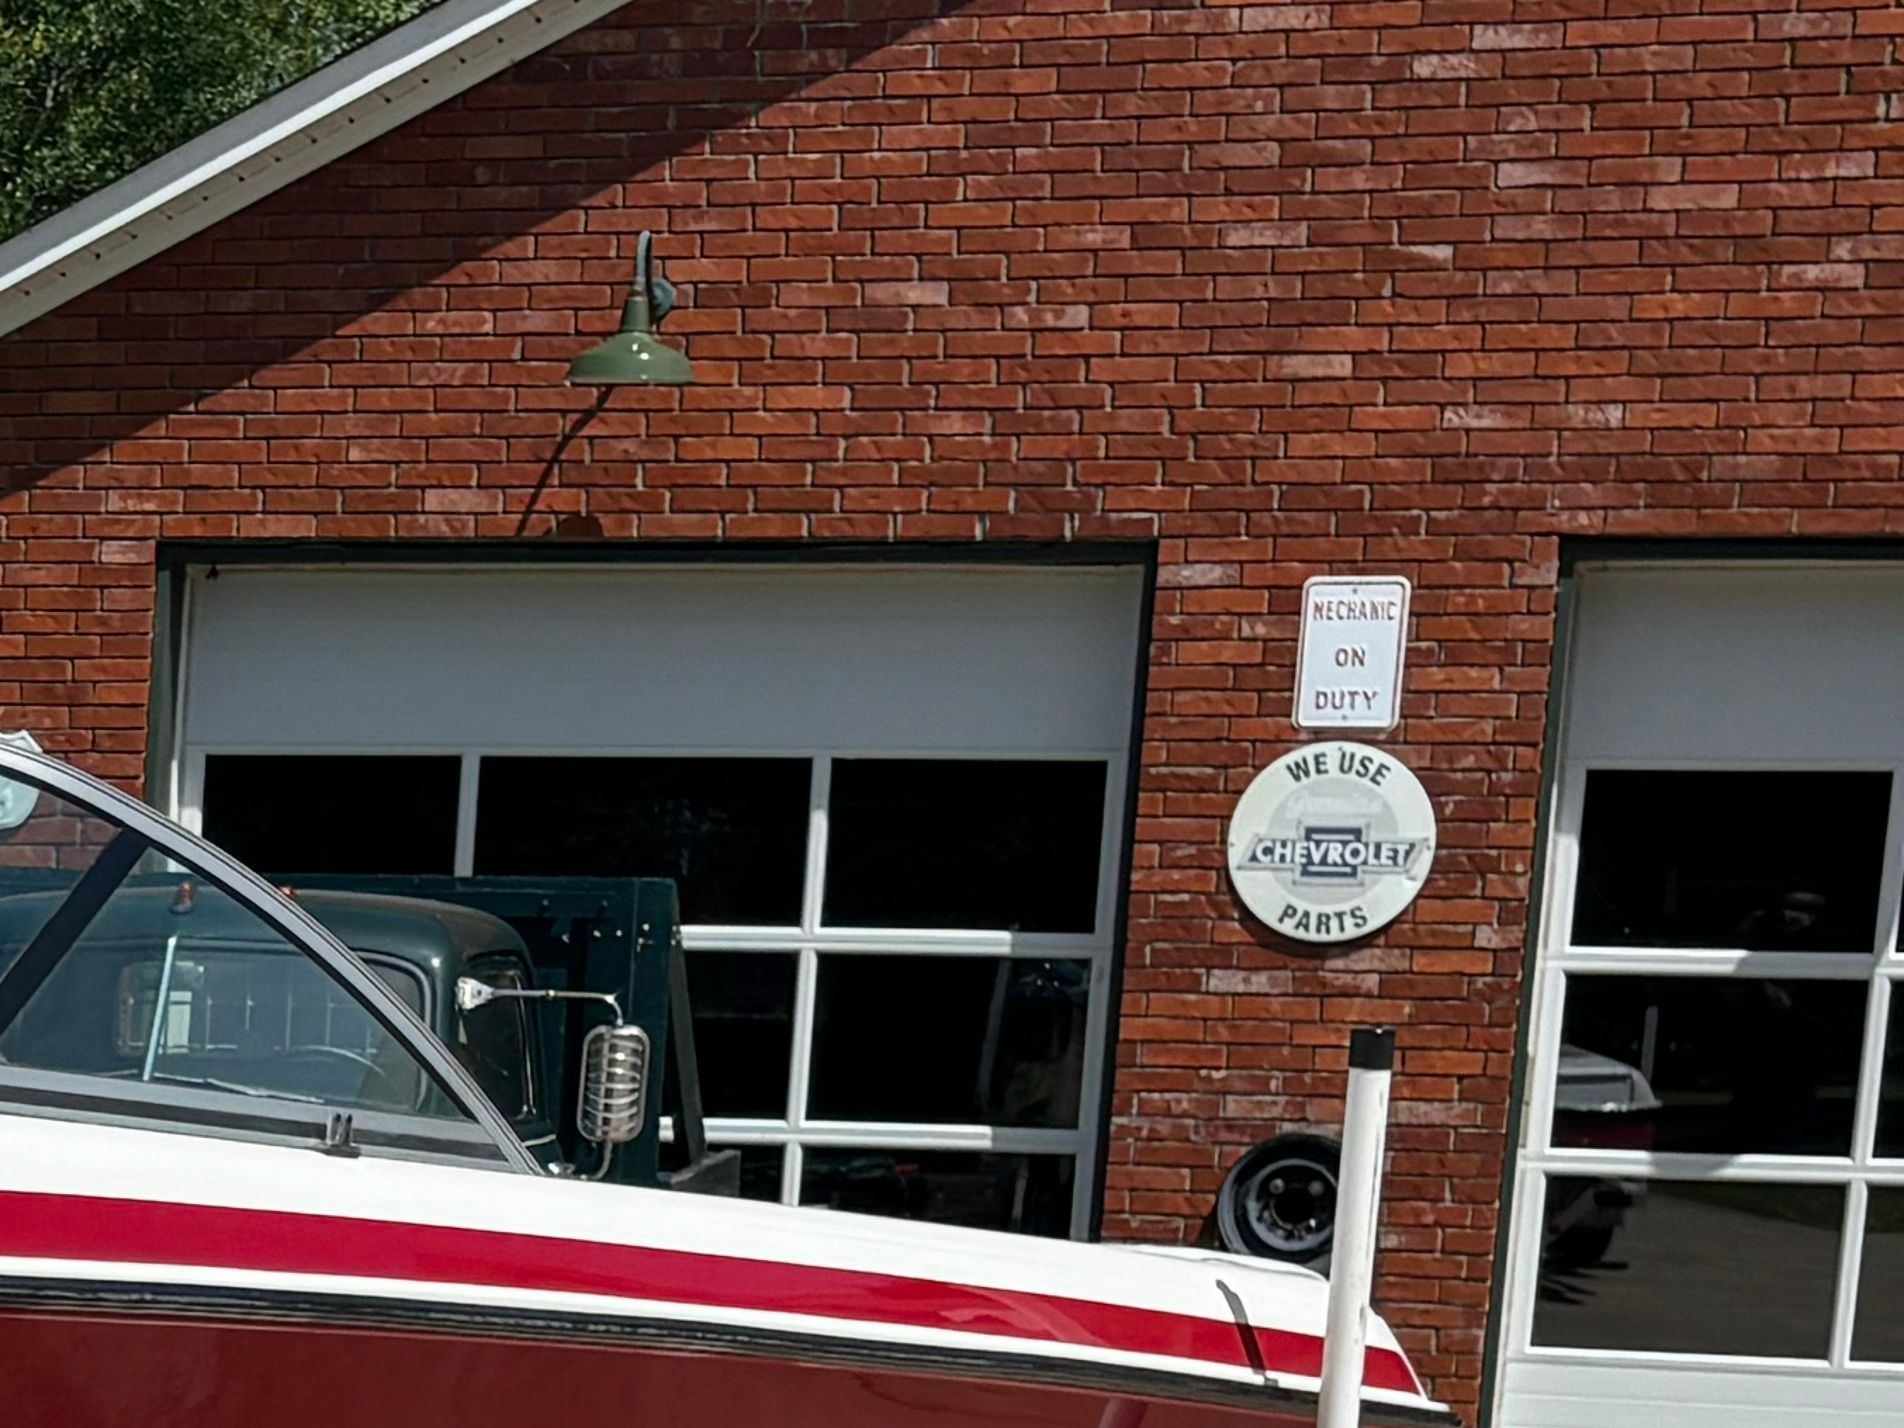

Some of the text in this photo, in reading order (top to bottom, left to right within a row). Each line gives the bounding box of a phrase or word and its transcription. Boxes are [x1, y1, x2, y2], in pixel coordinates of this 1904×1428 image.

[1312, 600, 1398, 621] MECHANIC
[1334, 647, 1367, 668] ON
[1314, 690, 1379, 711] DUTY
[1285, 750, 1392, 787] WE USE
[1254, 839, 1411, 866] CHEVROLET
[1277, 903, 1369, 936] PARTS
